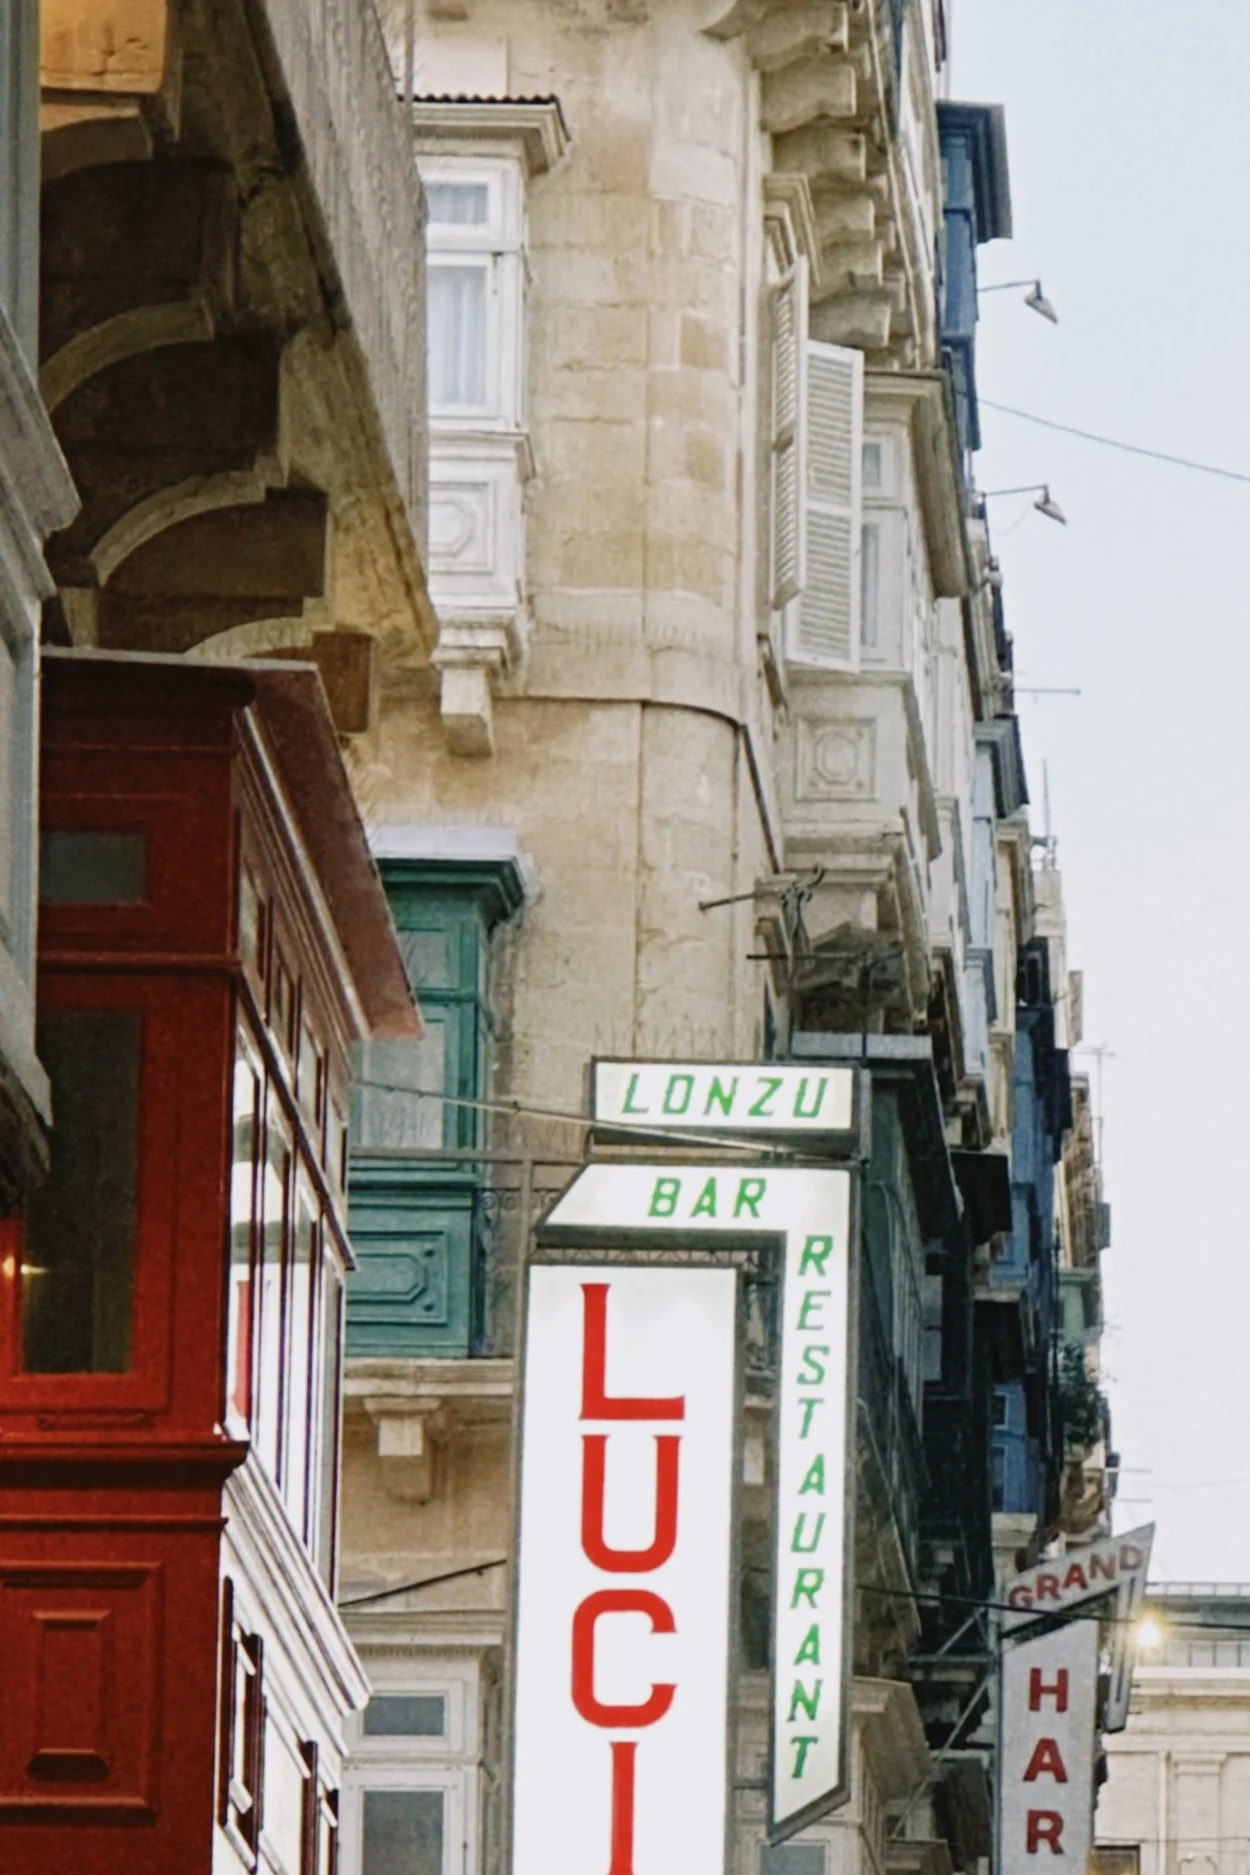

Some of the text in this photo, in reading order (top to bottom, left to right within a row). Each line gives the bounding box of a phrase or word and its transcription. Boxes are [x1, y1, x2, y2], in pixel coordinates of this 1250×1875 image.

[622, 1074, 828, 1118] LONZU
[648, 1178, 768, 1219] BAR
[788, 1233, 834, 1780] RESTAURANT
[1008, 1544, 1143, 1610] GRAND
